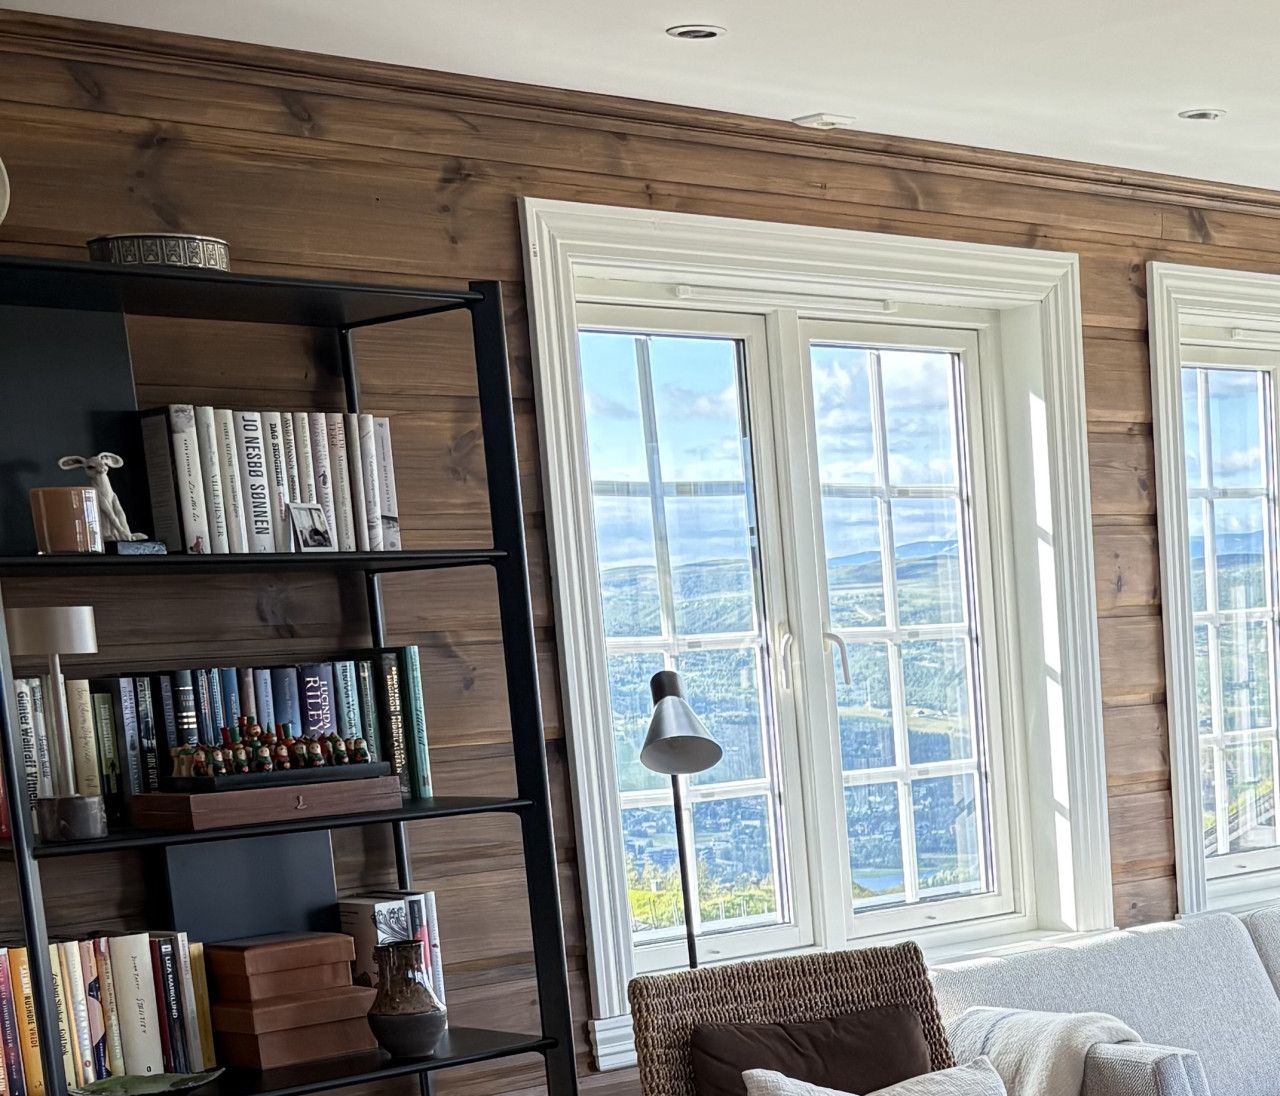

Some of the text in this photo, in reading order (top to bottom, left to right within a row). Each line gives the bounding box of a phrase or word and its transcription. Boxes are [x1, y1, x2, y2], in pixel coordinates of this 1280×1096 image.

[269, 423, 279, 441] DAG
[242, 415, 270, 536] JO NESBØ SØNNEN
[17, 691, 30, 725] Günter
[305, 676, 324, 734] RILEY
[320, 680, 331, 729] LUCINDA
[21, 728, 37, 768] Wallraff
[165, 956, 178, 1019] LIZA MARKLUND
[24, 995, 35, 1025] RUSHDIE
